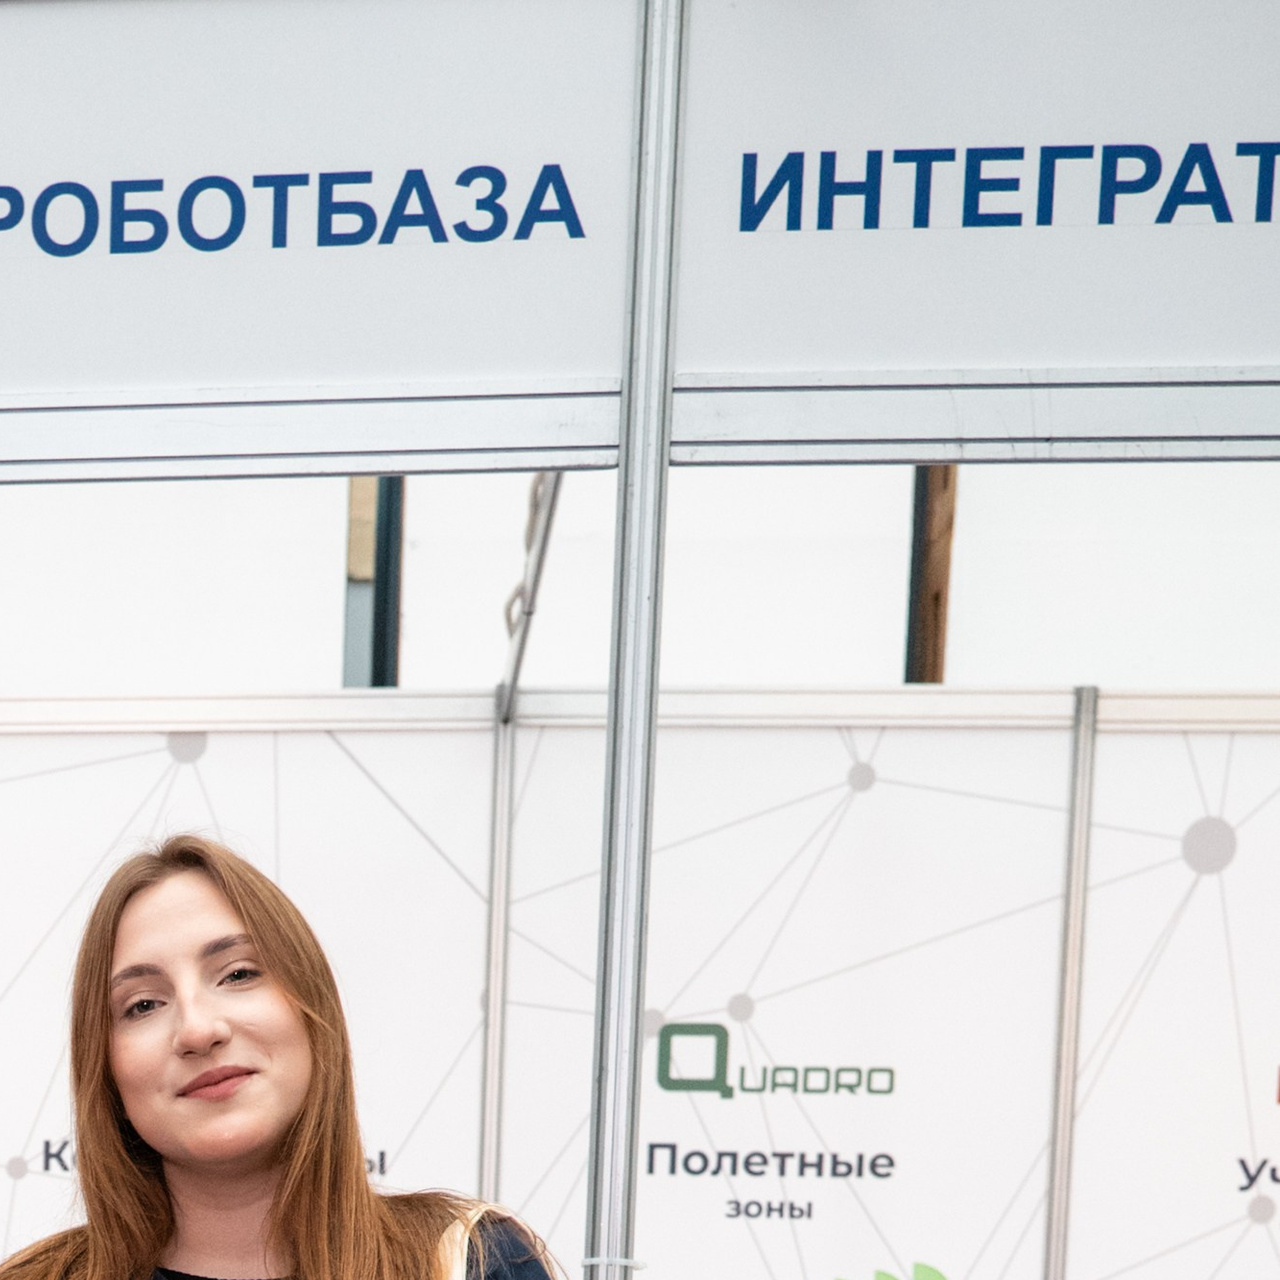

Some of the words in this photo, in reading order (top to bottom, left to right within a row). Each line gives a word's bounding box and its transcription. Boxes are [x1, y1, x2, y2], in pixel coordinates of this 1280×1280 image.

[738, 142, 1280, 232] ИНТЕГРАТ
[646, 1143, 895, 1178] Полетные
[725, 1200, 813, 1219] зоны
